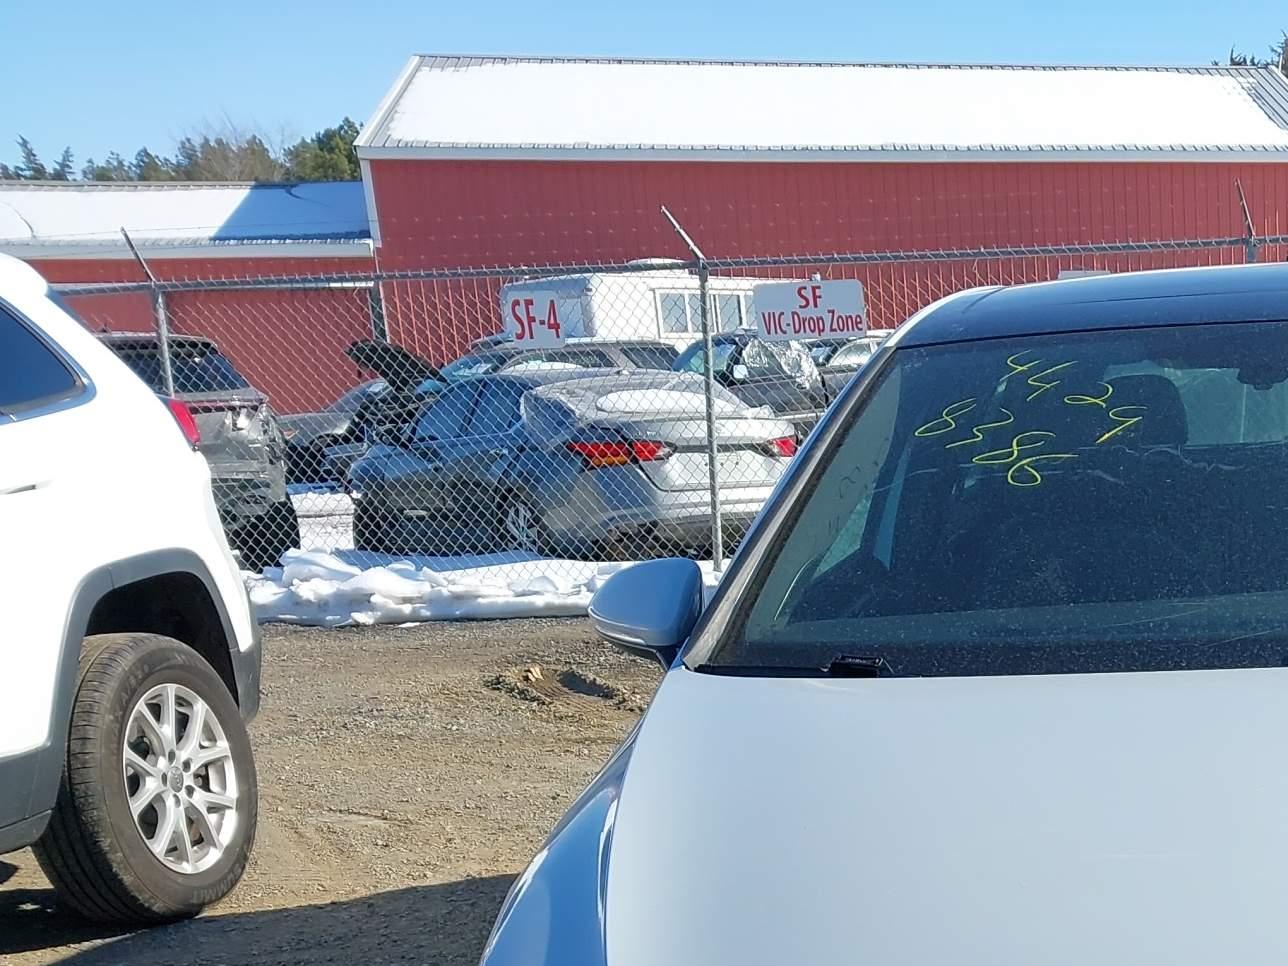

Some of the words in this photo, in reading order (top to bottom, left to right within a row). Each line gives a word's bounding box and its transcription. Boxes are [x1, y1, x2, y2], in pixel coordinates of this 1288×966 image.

[796, 284, 822, 309] SF
[511, 298, 561, 340] SF-4
[761, 310, 826, 337] VIC-Drop
[827, 309, 863, 333] Zone
